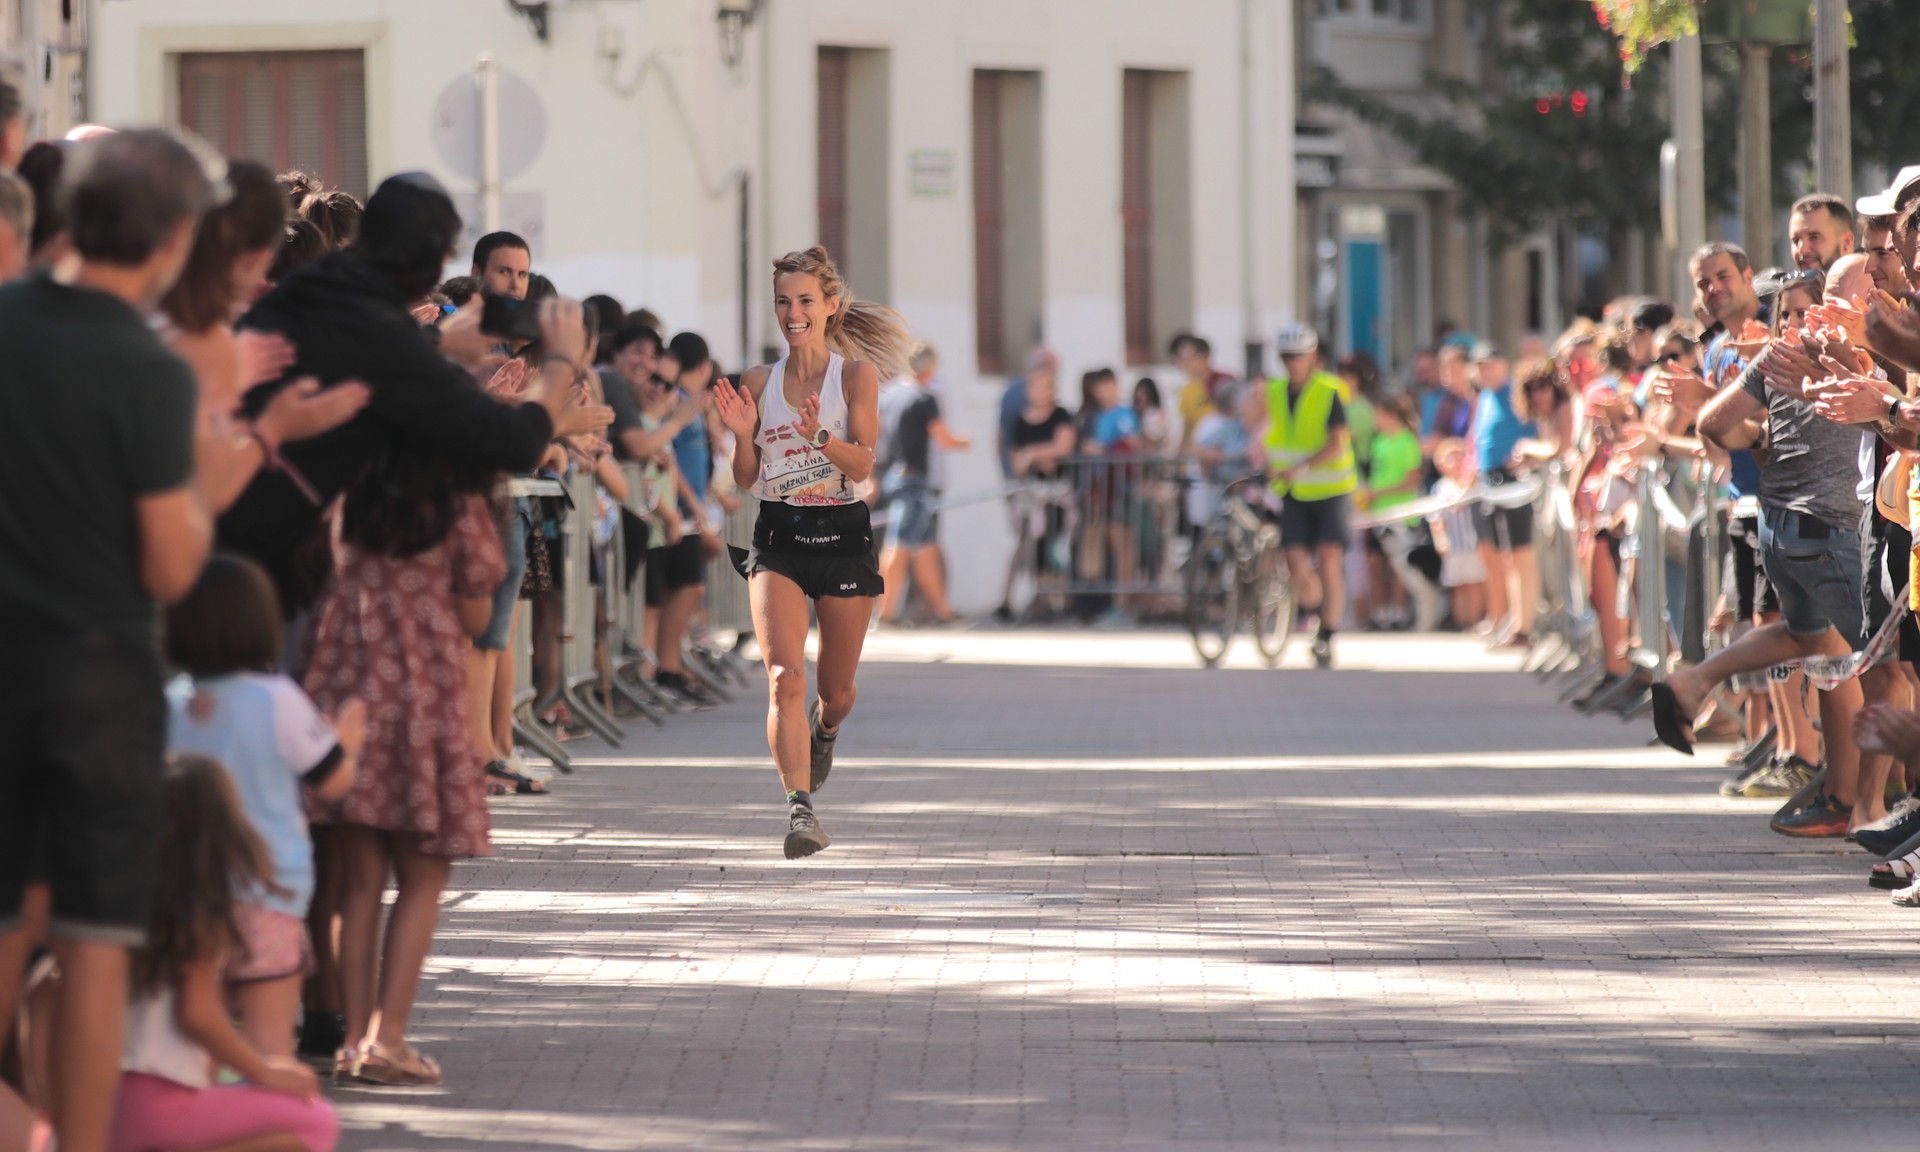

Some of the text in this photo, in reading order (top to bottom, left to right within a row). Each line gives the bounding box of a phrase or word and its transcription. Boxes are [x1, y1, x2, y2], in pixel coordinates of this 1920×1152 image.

[798, 456, 824, 468] LANA
[811, 467, 834, 480] TRAIL
[794, 534, 841, 543] SALOMON
